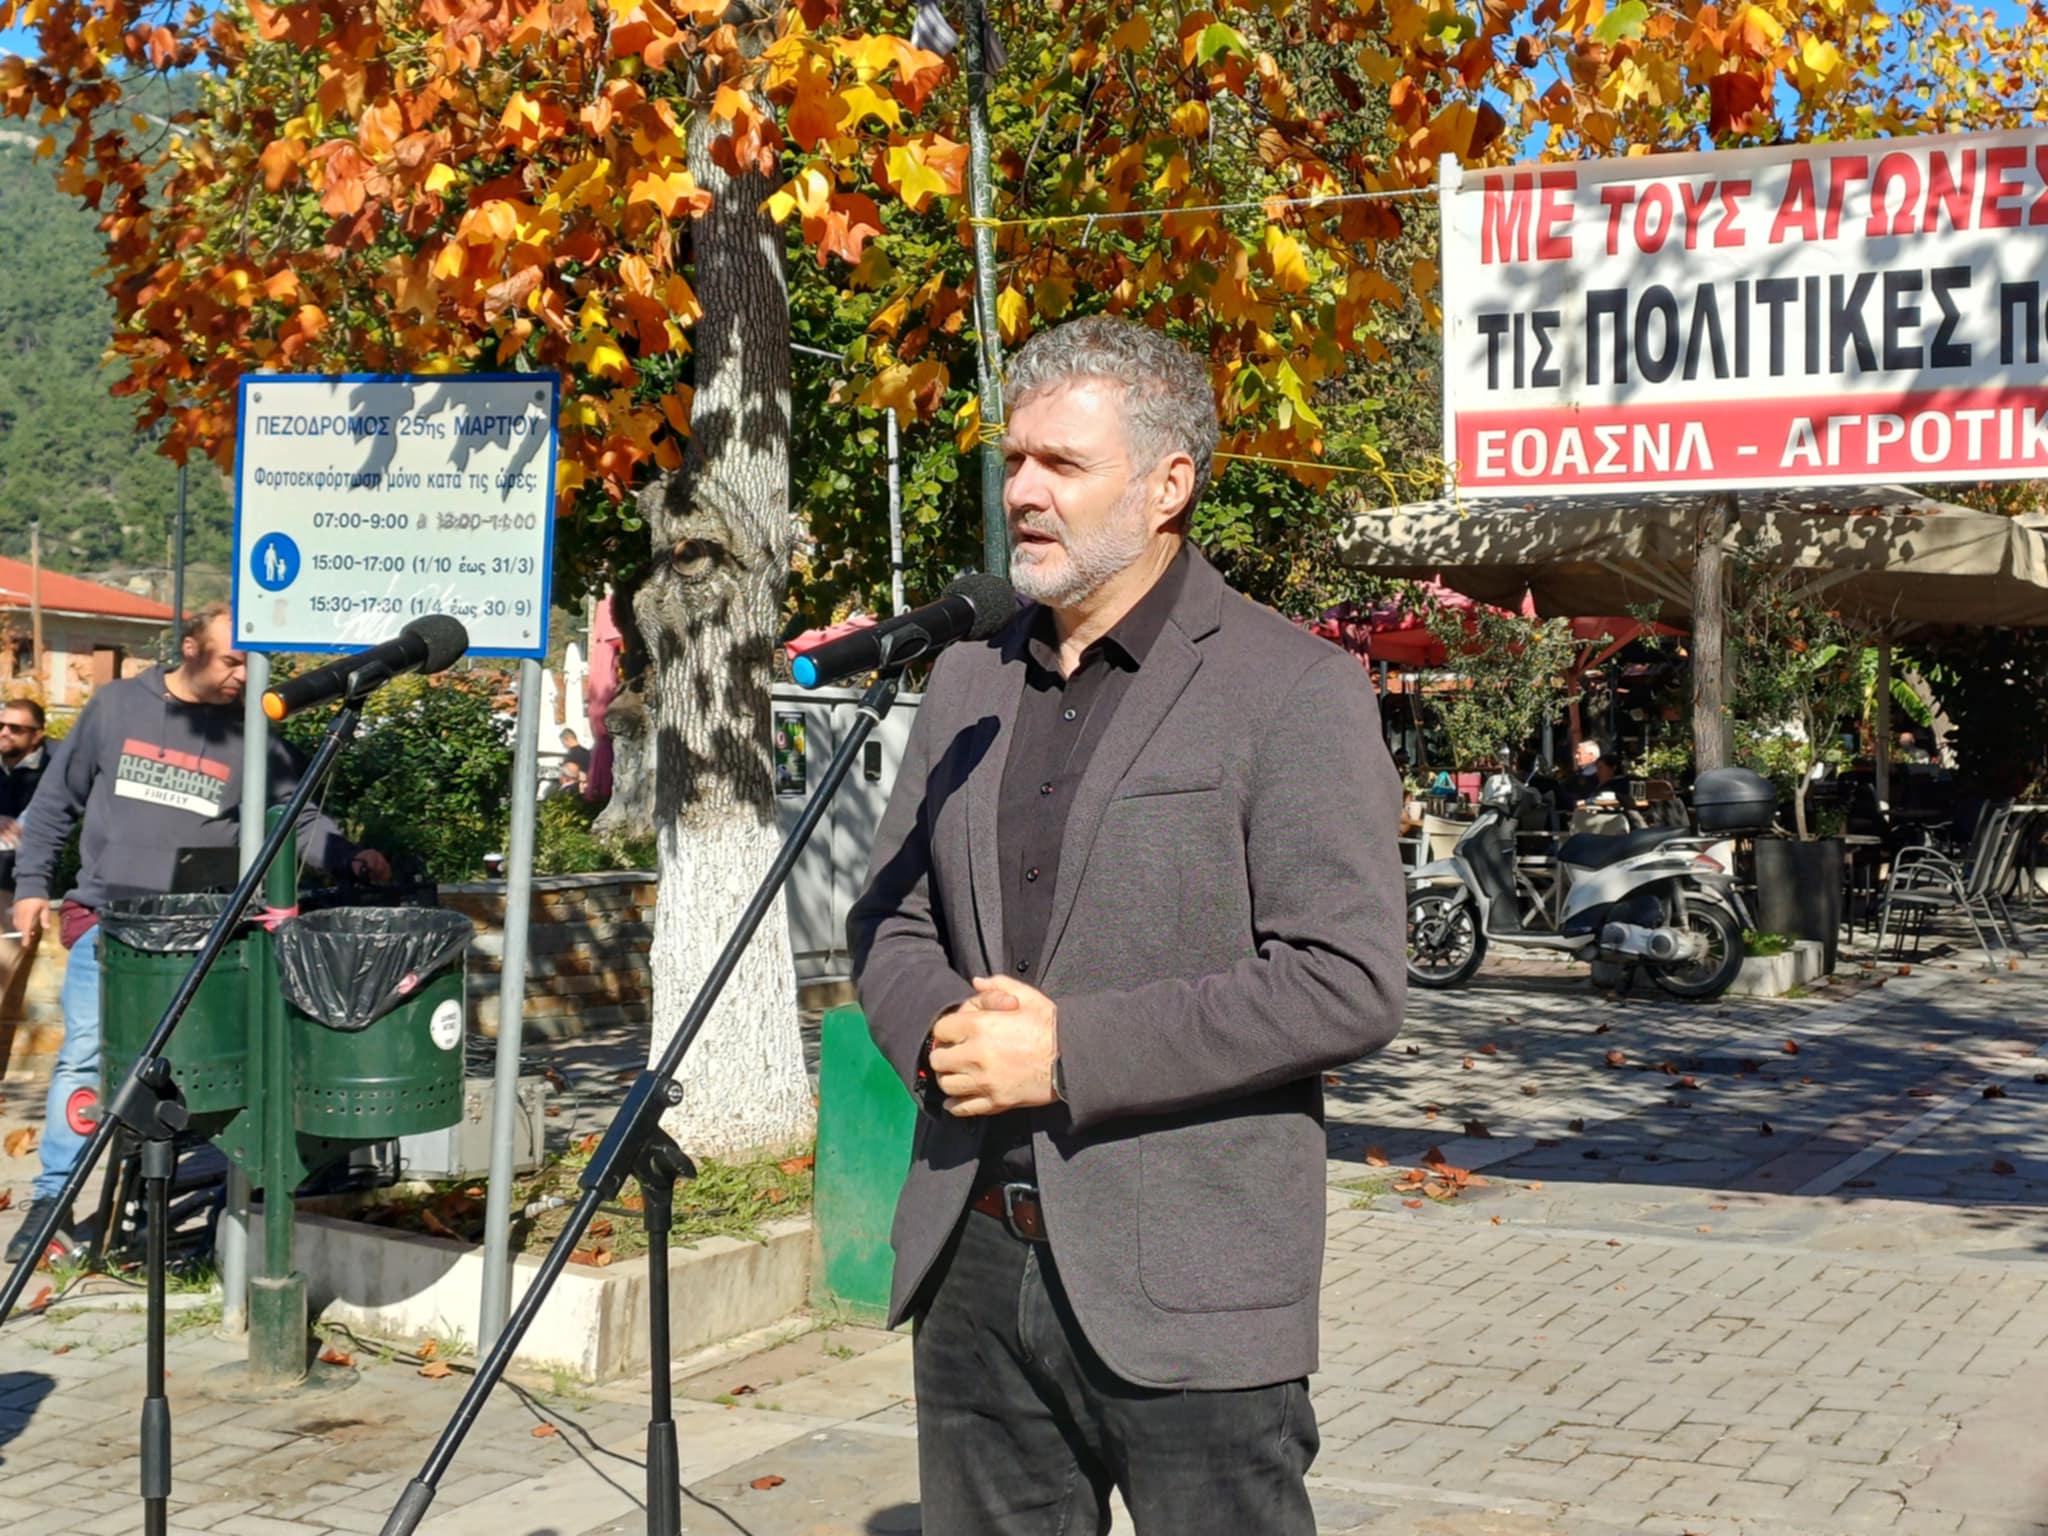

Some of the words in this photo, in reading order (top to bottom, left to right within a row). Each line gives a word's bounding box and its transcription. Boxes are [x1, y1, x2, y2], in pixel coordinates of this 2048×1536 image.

[1481, 171, 1577, 264] ΜΕ
[1600, 180, 1752, 256] ΤΟΥΣ
[1477, 311, 1561, 390] ΤΙΣ
[1586, 266, 1972, 385] ΠΟΛΙΤΙΚΕΣ
[2000, 281, 2048, 365] Π
[256, 415, 391, 436] ΠΕΖΟΔΡΟΜΟΣ
[400, 416, 445, 439] 25ης
[454, 415, 540, 436] ΜΑΡΤΙΟΥ
[1476, 421, 1714, 478] ΕΟΑΣΝΛ
[254, 465, 380, 492] Φορτοεκφόρτωση
[387, 467, 421, 492] μόνο
[427, 467, 462, 488] κατά
[469, 473, 489, 494] τις
[496, 467, 537, 493] ώρες:
[313, 512, 408, 529] 07:00-9:00
[312, 555, 405, 572] 15:00-17:00
[412, 555, 452, 574] (1/10
[459, 556, 486, 576] έως
[492, 556, 534, 575] 31/3)
[309, 596, 402, 613] 15:30-17:30
[449, 598, 478, 618] έως
